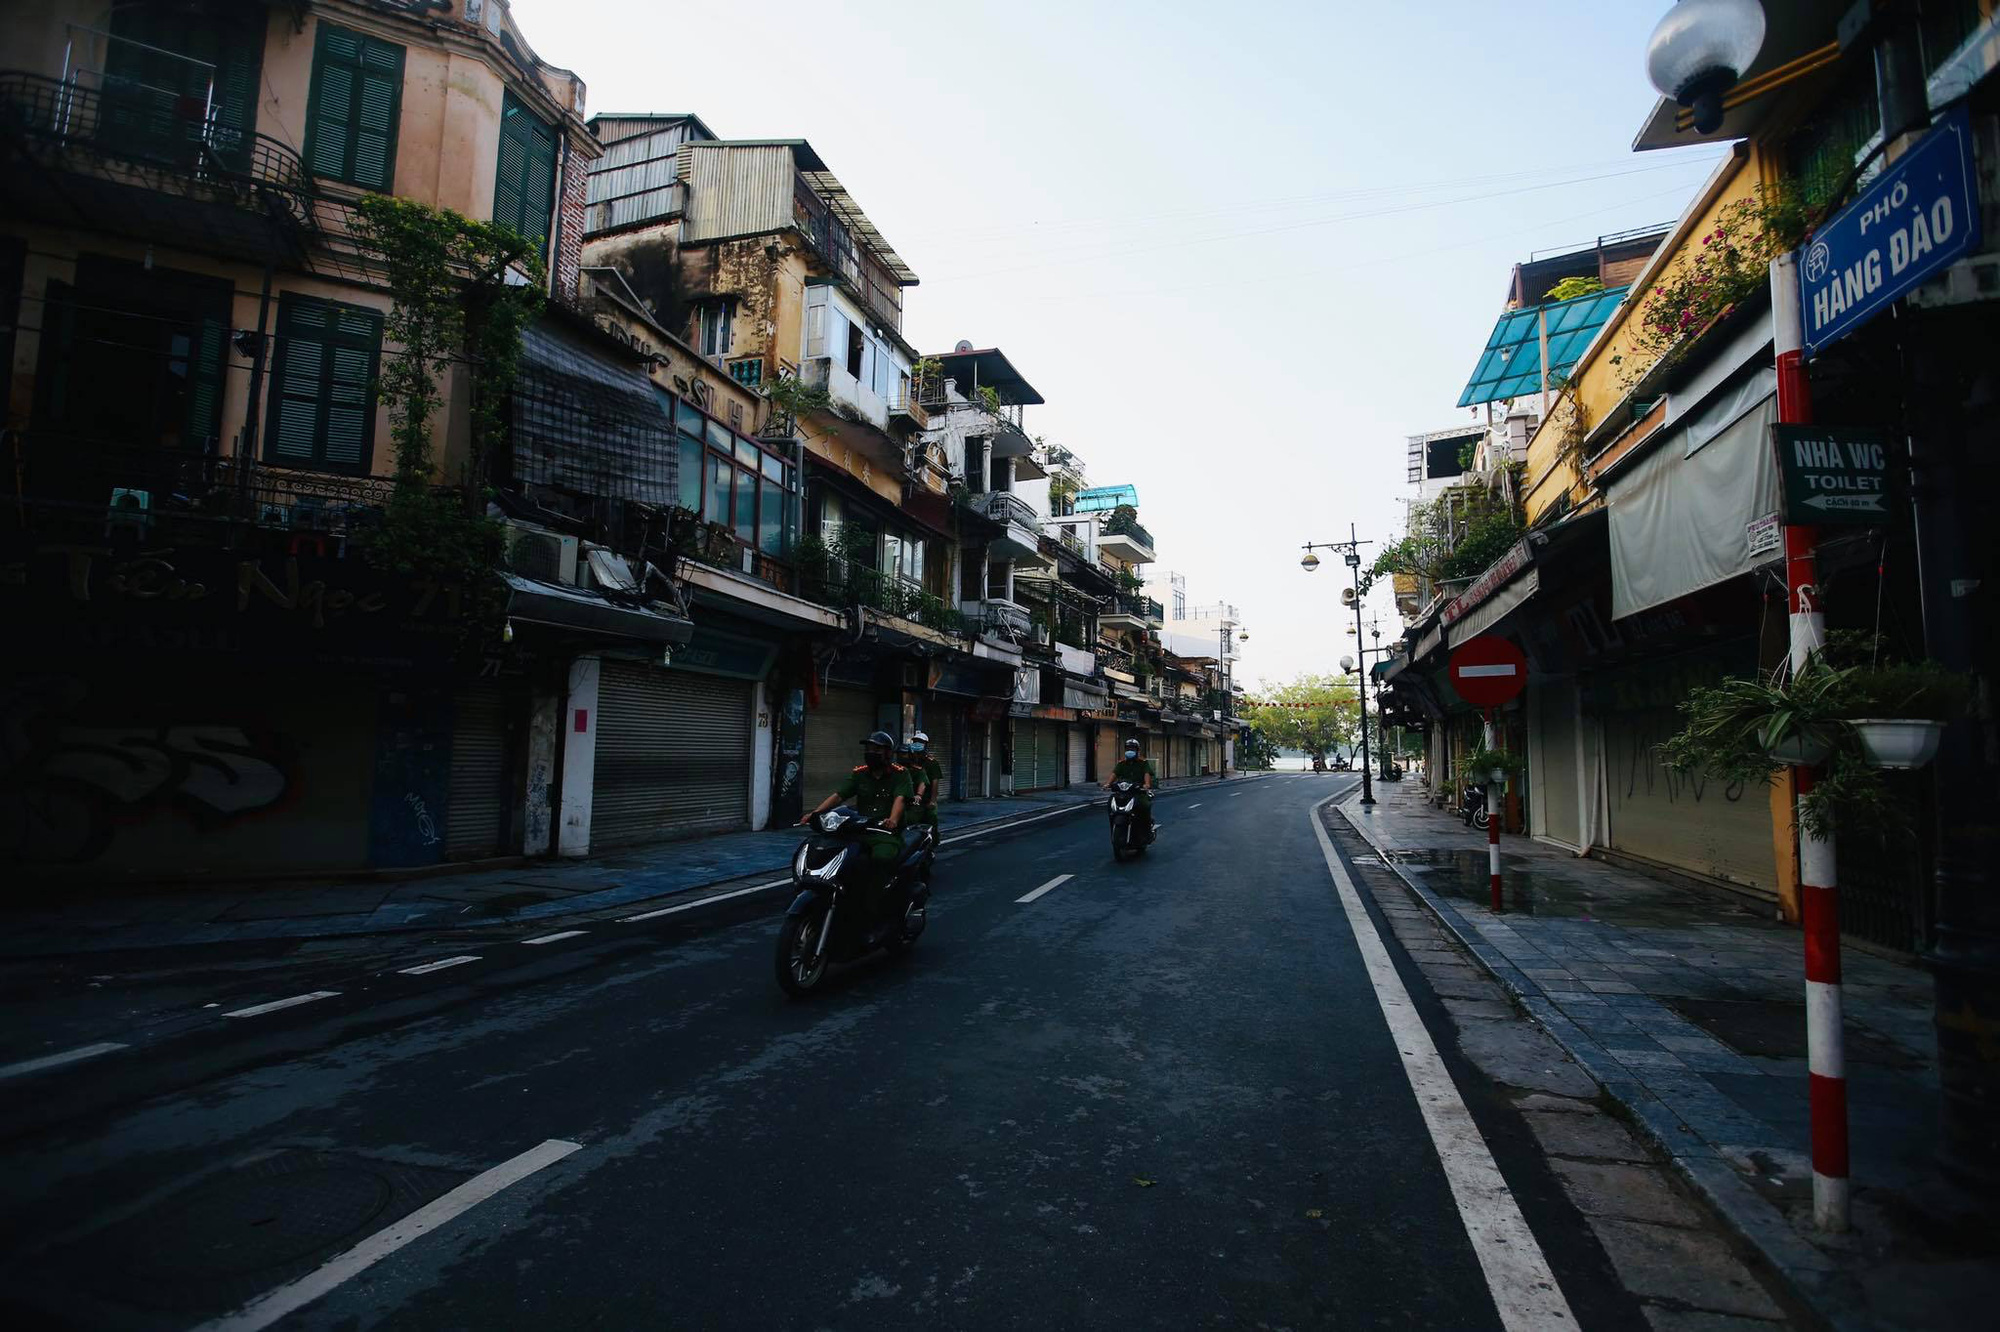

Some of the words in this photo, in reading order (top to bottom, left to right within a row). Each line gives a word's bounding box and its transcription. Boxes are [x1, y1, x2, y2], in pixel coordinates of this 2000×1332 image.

[1859, 171, 1909, 236] PHỐ
[1813, 248, 1883, 331] HÀNG
[1889, 195, 1954, 277] ĐÀO
[1794, 435, 1845, 468] NHÀ
[1847, 443, 1885, 470] WC
[1804, 475, 1882, 490] TOILET
[1825, 497, 1849, 506] CÁCH
